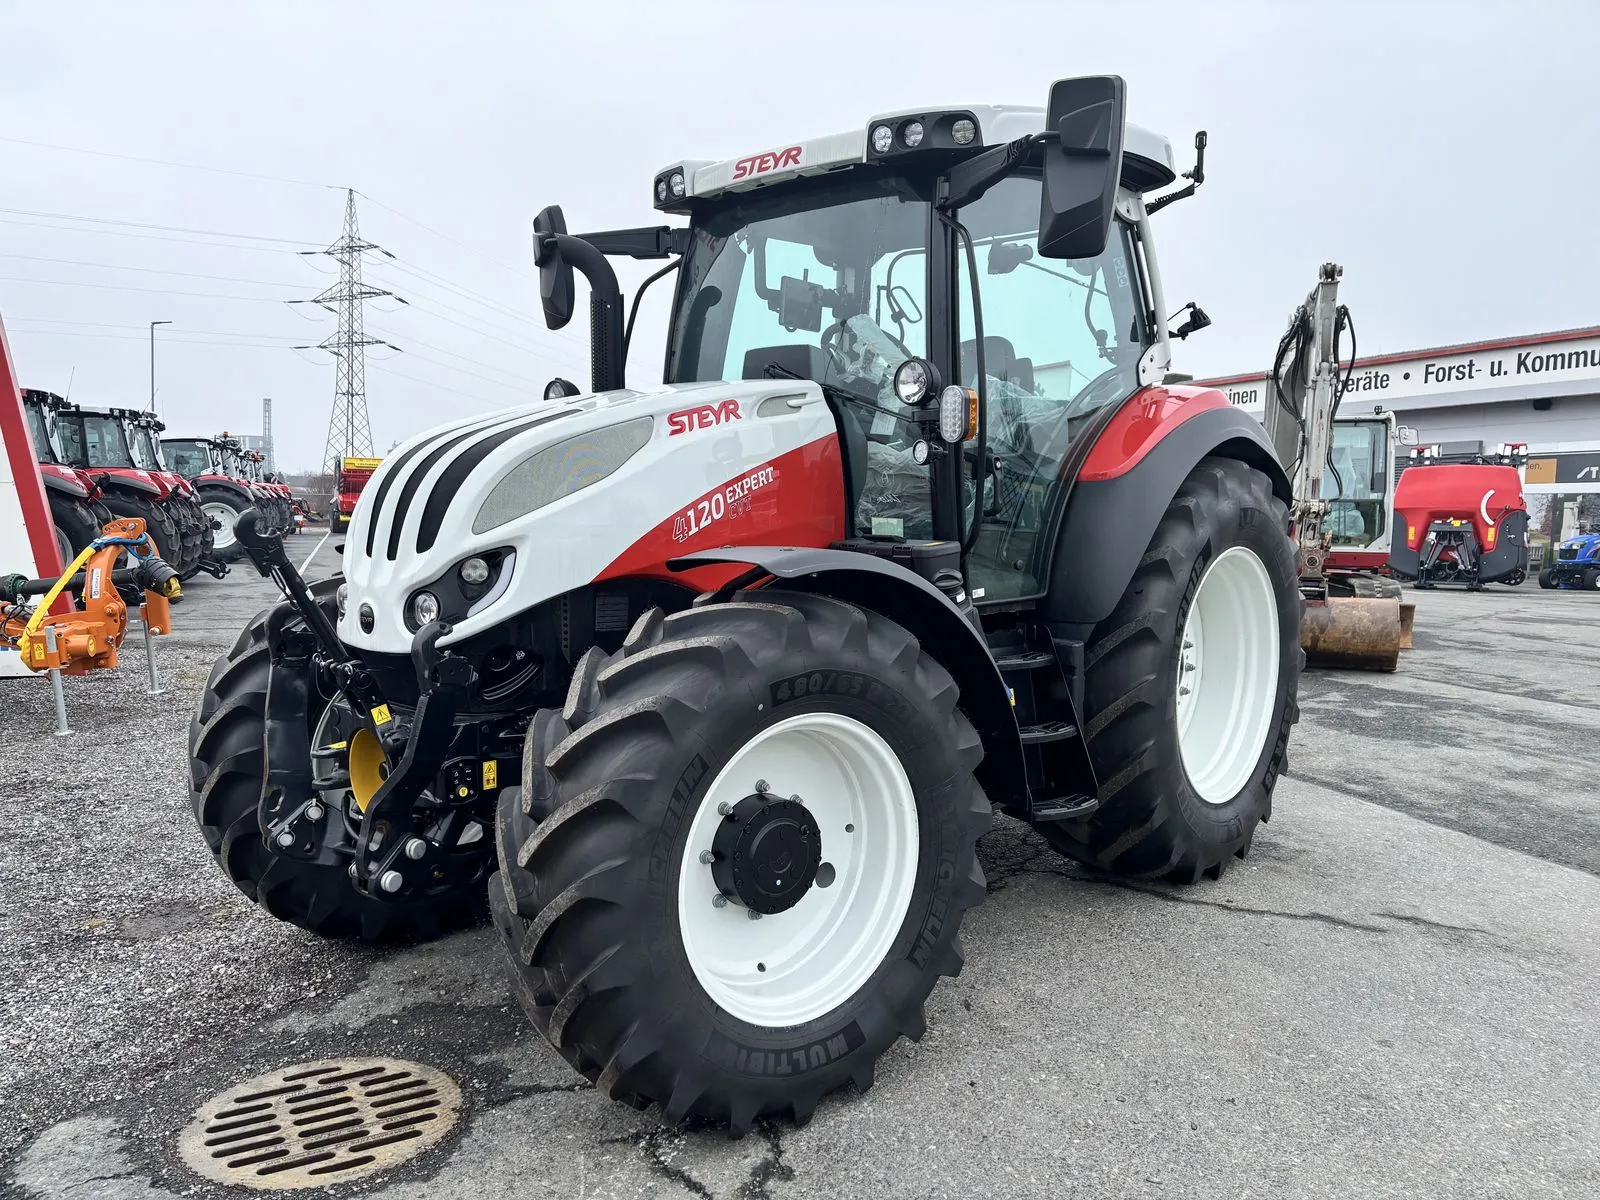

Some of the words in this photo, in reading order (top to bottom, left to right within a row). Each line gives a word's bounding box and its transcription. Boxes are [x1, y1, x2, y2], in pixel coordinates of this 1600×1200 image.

[733, 146, 802, 180] STEYR
[1225, 388, 1257, 405] inen
[1424, 359, 1482, 384] Forst-
[1490, 360, 1508, 377] u.
[667, 399, 742, 437] STEYR
[672, 492, 725, 543] 4120
[726, 466, 774, 503] EXPERT
[728, 495, 752, 520] CVT
